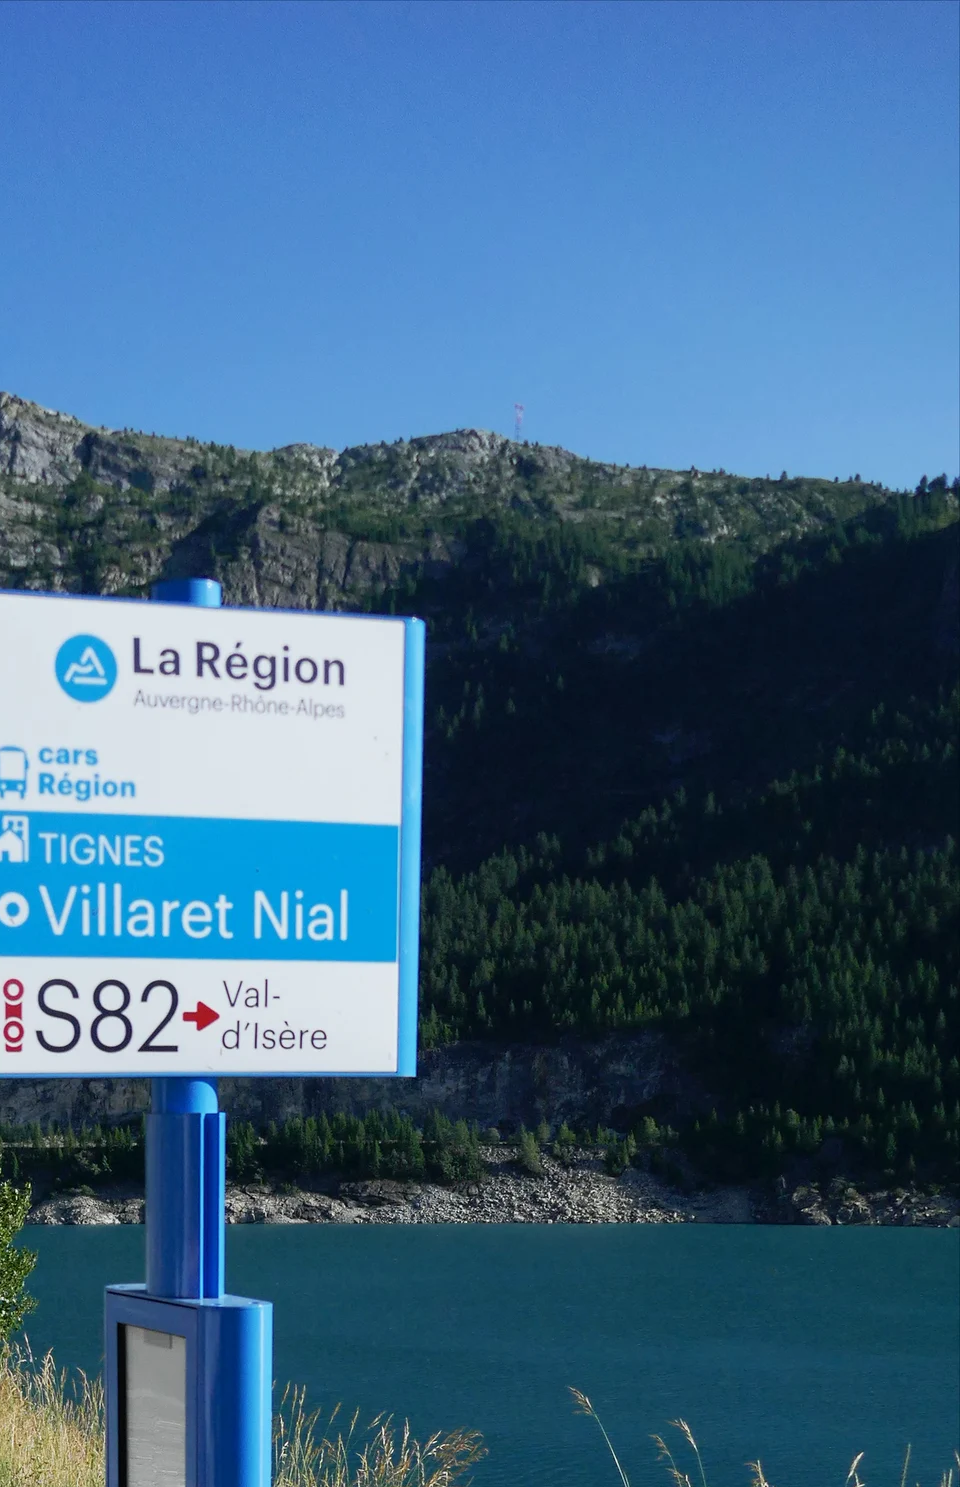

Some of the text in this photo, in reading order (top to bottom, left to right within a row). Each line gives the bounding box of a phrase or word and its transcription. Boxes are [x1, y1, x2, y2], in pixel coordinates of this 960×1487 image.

[133, 637, 346, 691] La Région
[133, 688, 346, 720] Auvergne-Rhône-Alpes
[38, 746, 99, 767] cars
[38, 772, 137, 802] Région
[38, 832, 166, 868] TIGNES
[38, 882, 349, 942] Villaret Nial
[222, 978, 281, 1008] Val-
[35, 978, 180, 1054] S82
[221, 1020, 328, 1050] d'Isère
